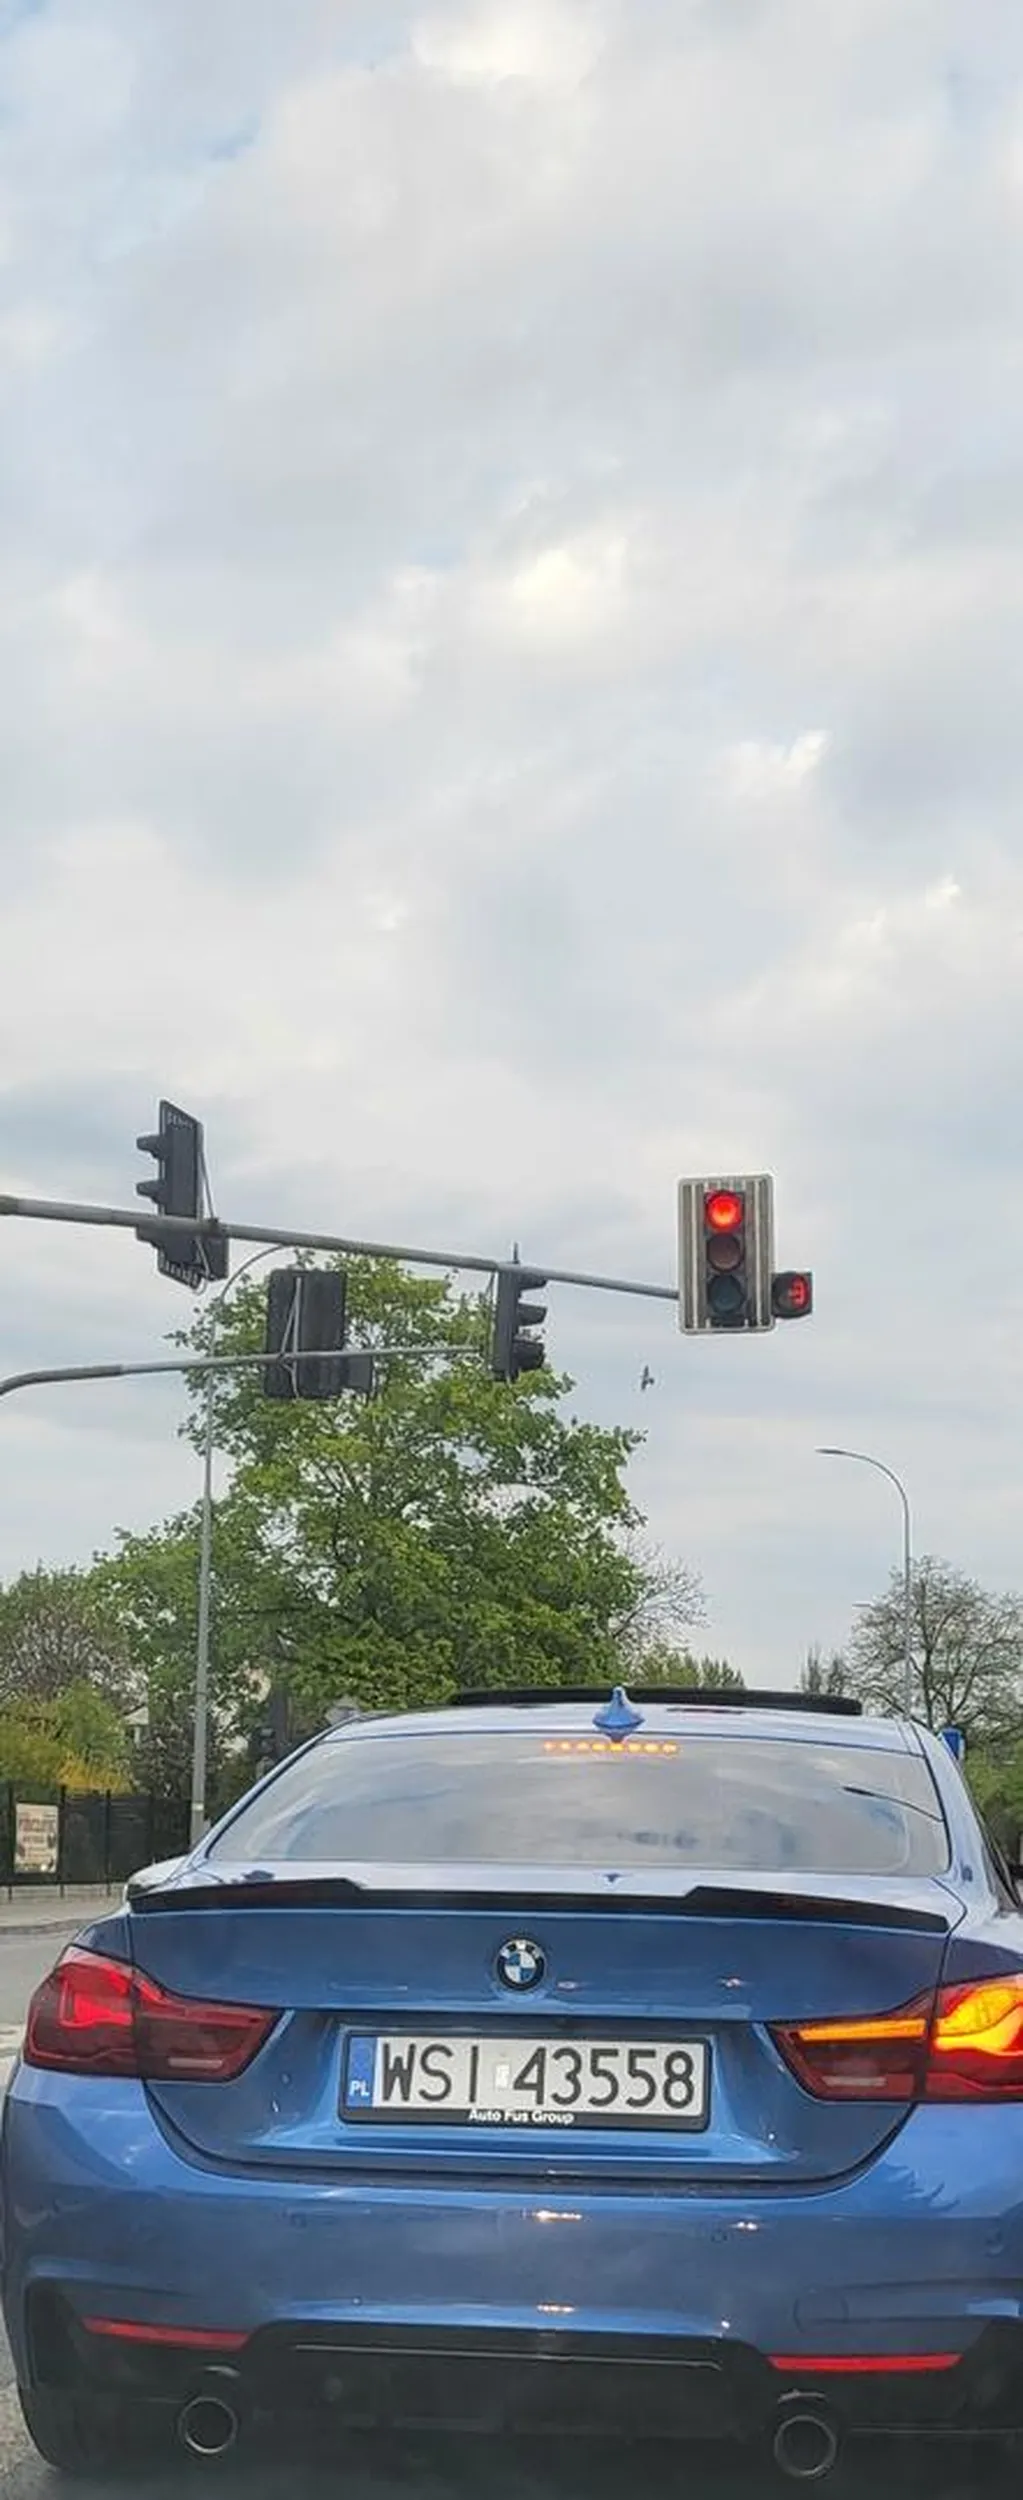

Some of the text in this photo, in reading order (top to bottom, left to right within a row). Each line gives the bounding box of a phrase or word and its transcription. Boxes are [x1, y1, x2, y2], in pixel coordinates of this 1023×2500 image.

[382, 2043, 695, 2109] WSI 43558
[349, 2080, 370, 2096] PL
[469, 2108, 574, 2125] Auto Fus Group
